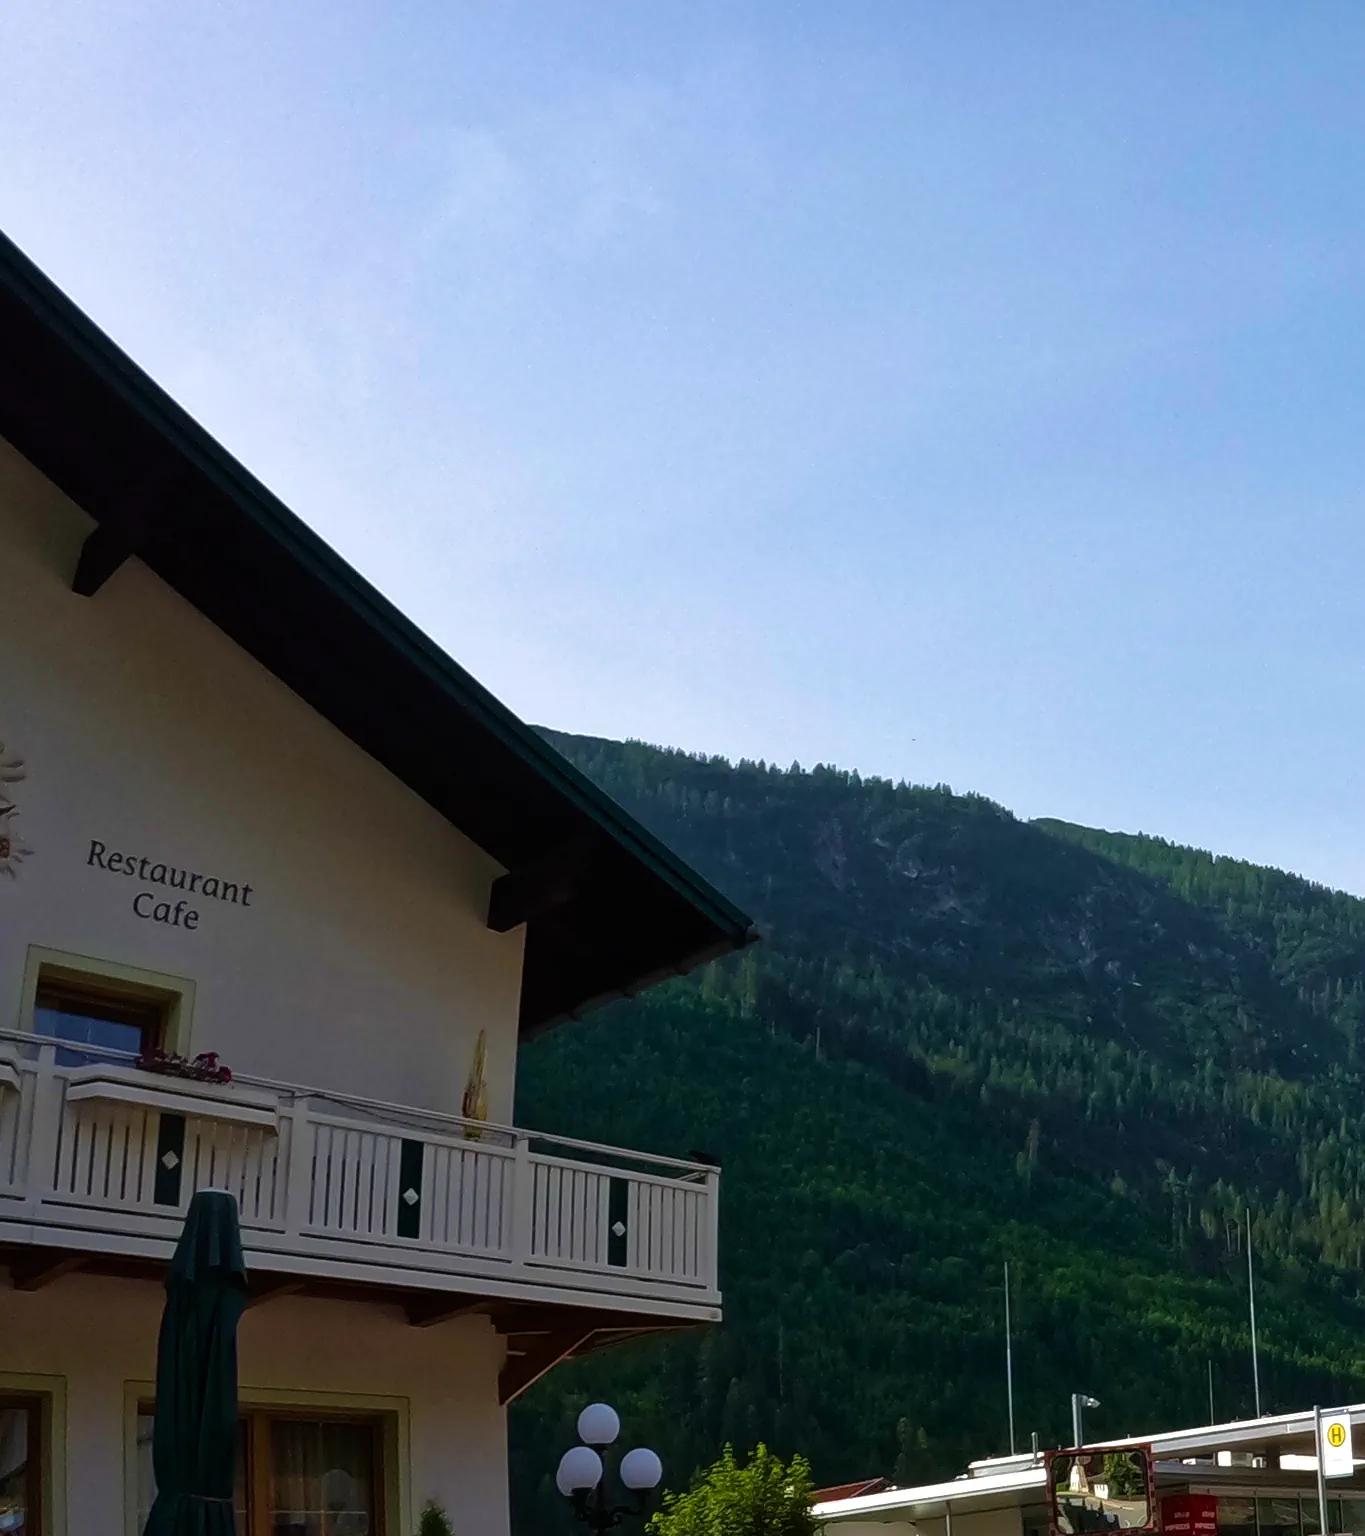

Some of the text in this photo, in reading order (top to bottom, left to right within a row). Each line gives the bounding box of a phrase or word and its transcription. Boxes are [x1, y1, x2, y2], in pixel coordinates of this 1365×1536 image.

[87, 839, 253, 906] Restaurant
[132, 892, 200, 930] Cafe
[1331, 1426, 1342, 1444] H
